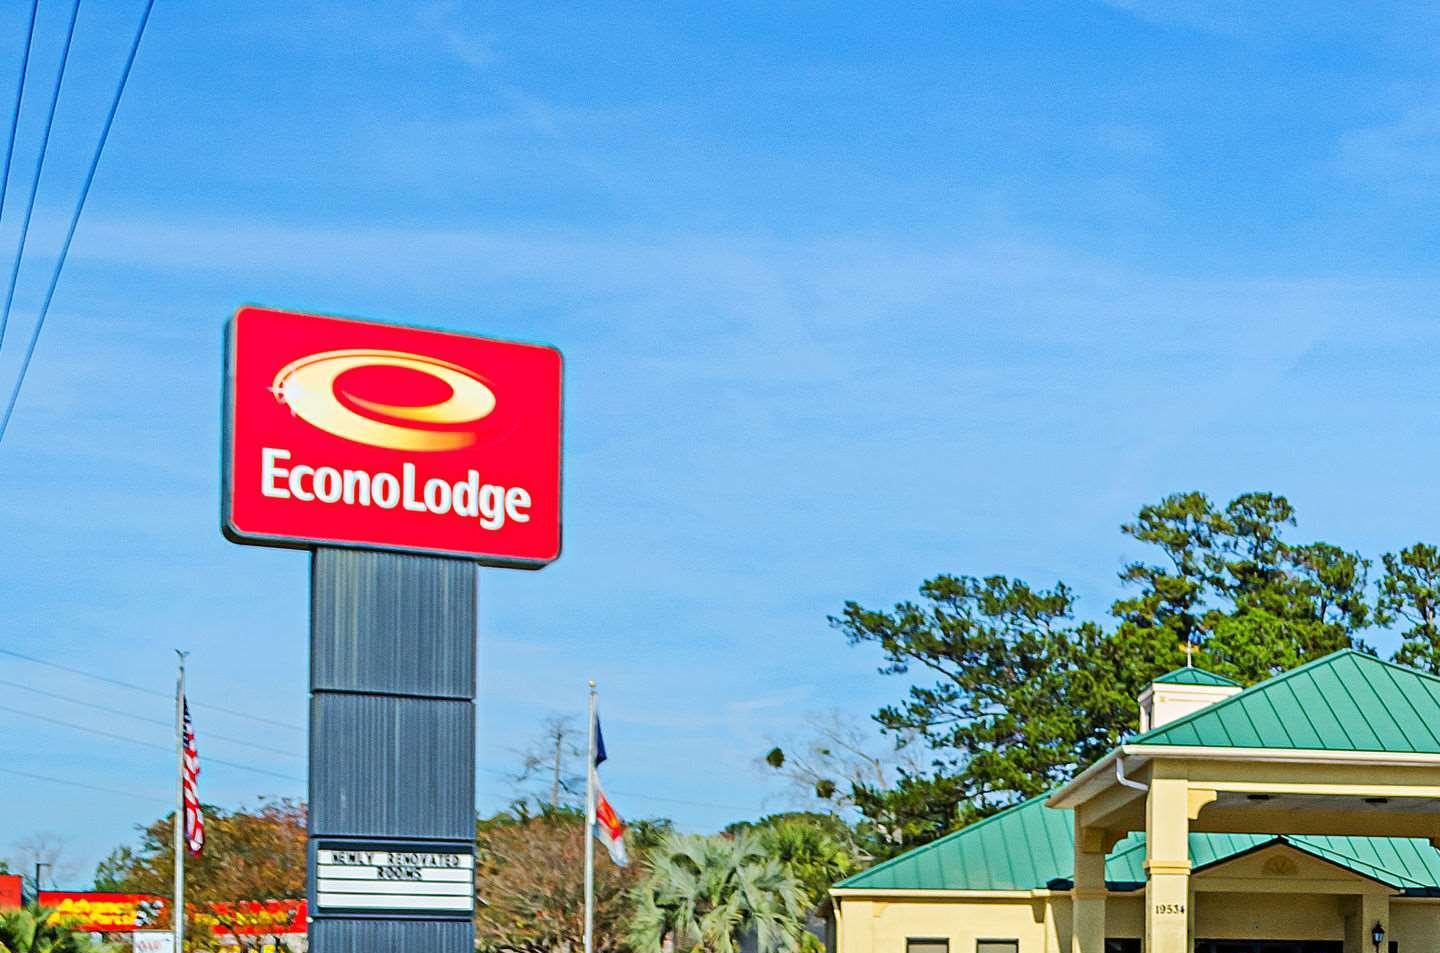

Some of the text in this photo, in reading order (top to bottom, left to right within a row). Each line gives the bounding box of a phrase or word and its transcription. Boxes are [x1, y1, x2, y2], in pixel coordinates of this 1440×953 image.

[261, 447, 532, 531] EconoLodge
[331, 851, 460, 868] NEWLY RENOVATED
[376, 866, 423, 880] ROOMS
[1155, 904, 1185, 915] 19534
